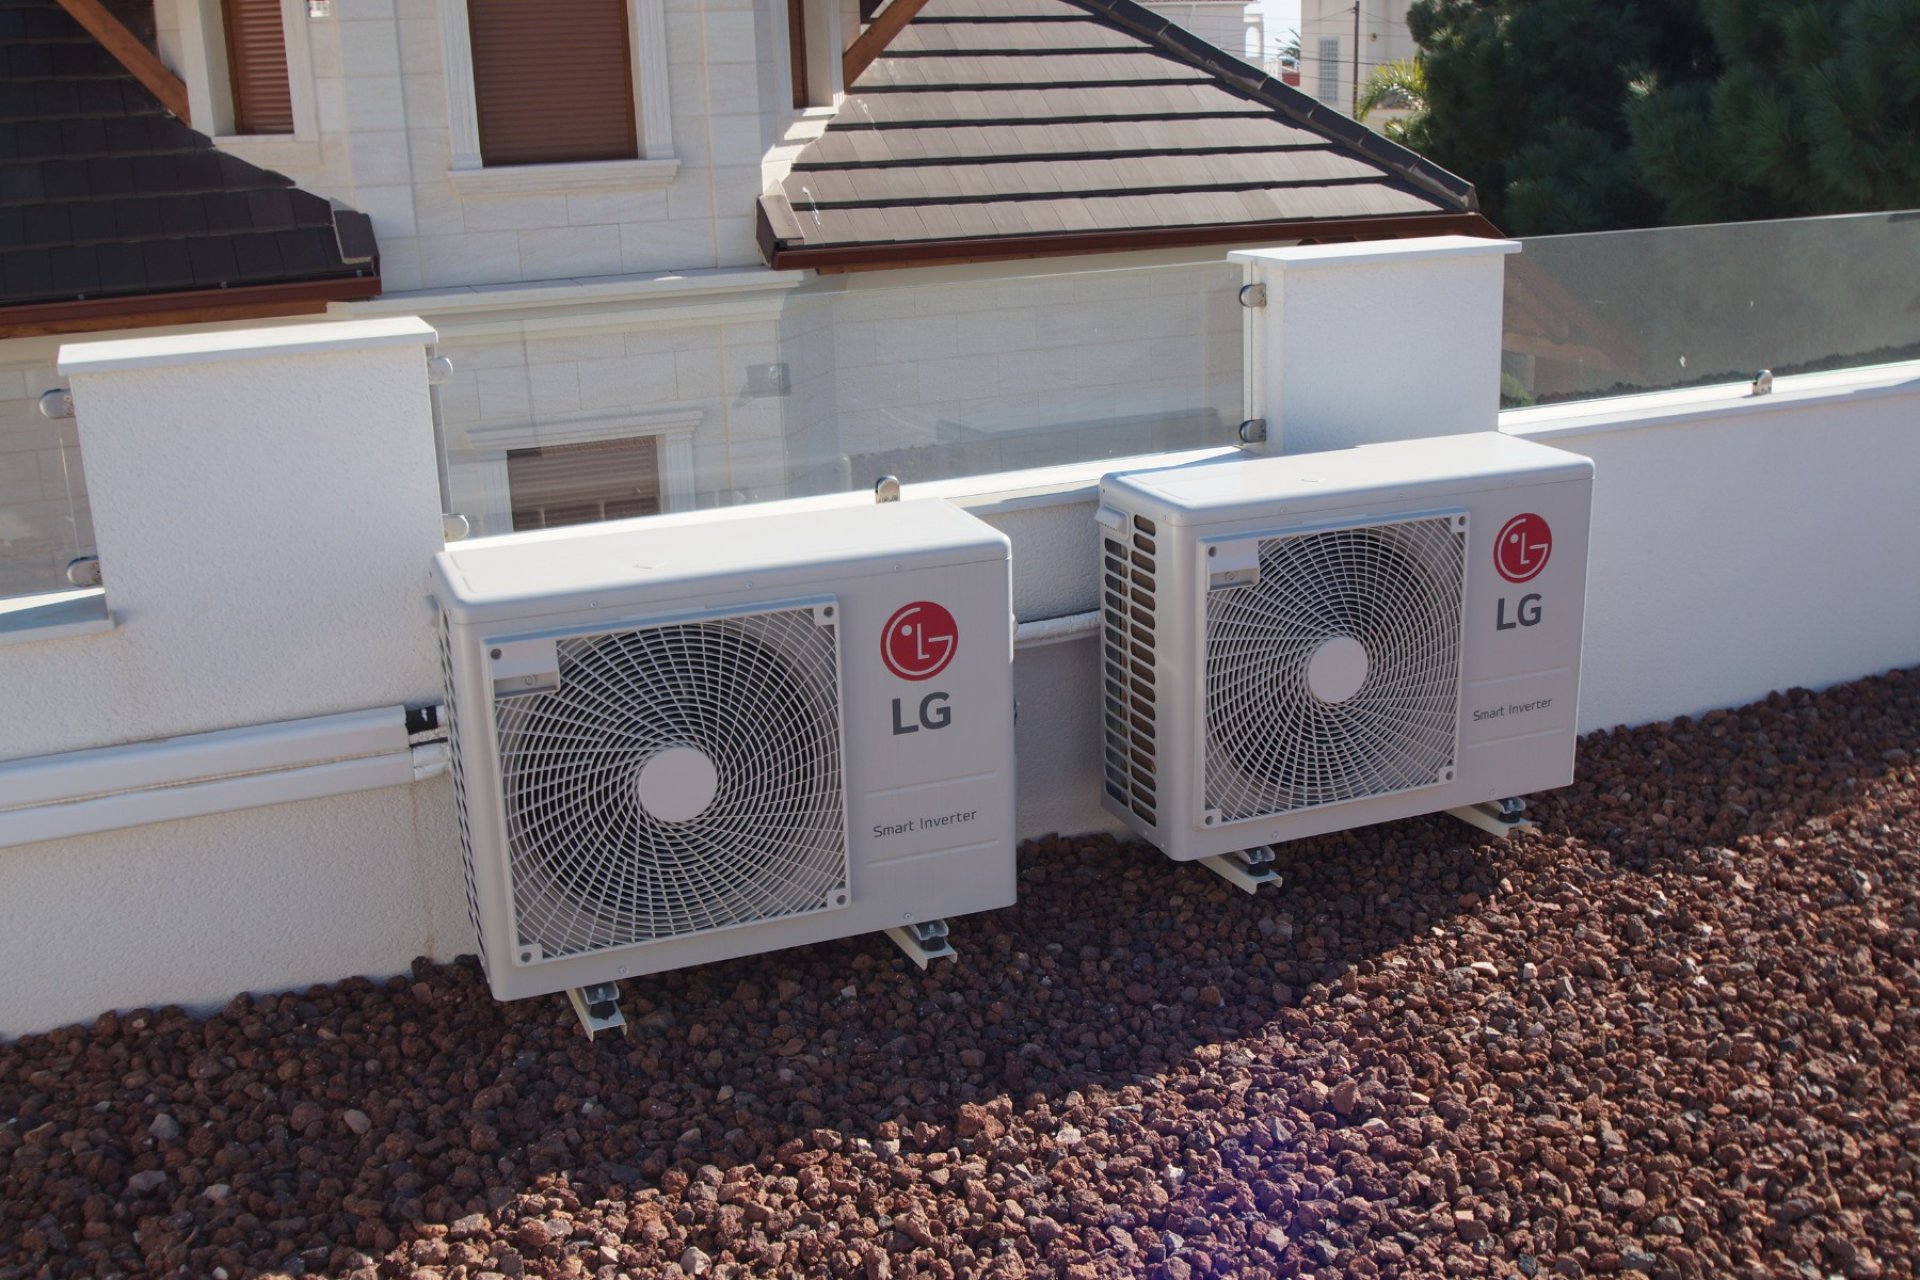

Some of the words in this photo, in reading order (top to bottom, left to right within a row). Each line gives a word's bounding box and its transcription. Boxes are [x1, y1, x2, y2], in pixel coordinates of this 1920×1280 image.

[1496, 593, 1543, 632] LG
[891, 691, 952, 736] LG
[1473, 706, 1504, 722] Smart
[1508, 698, 1553, 715] Inverter
[873, 820, 915, 838] Smart
[919, 810, 977, 830] Inverter
